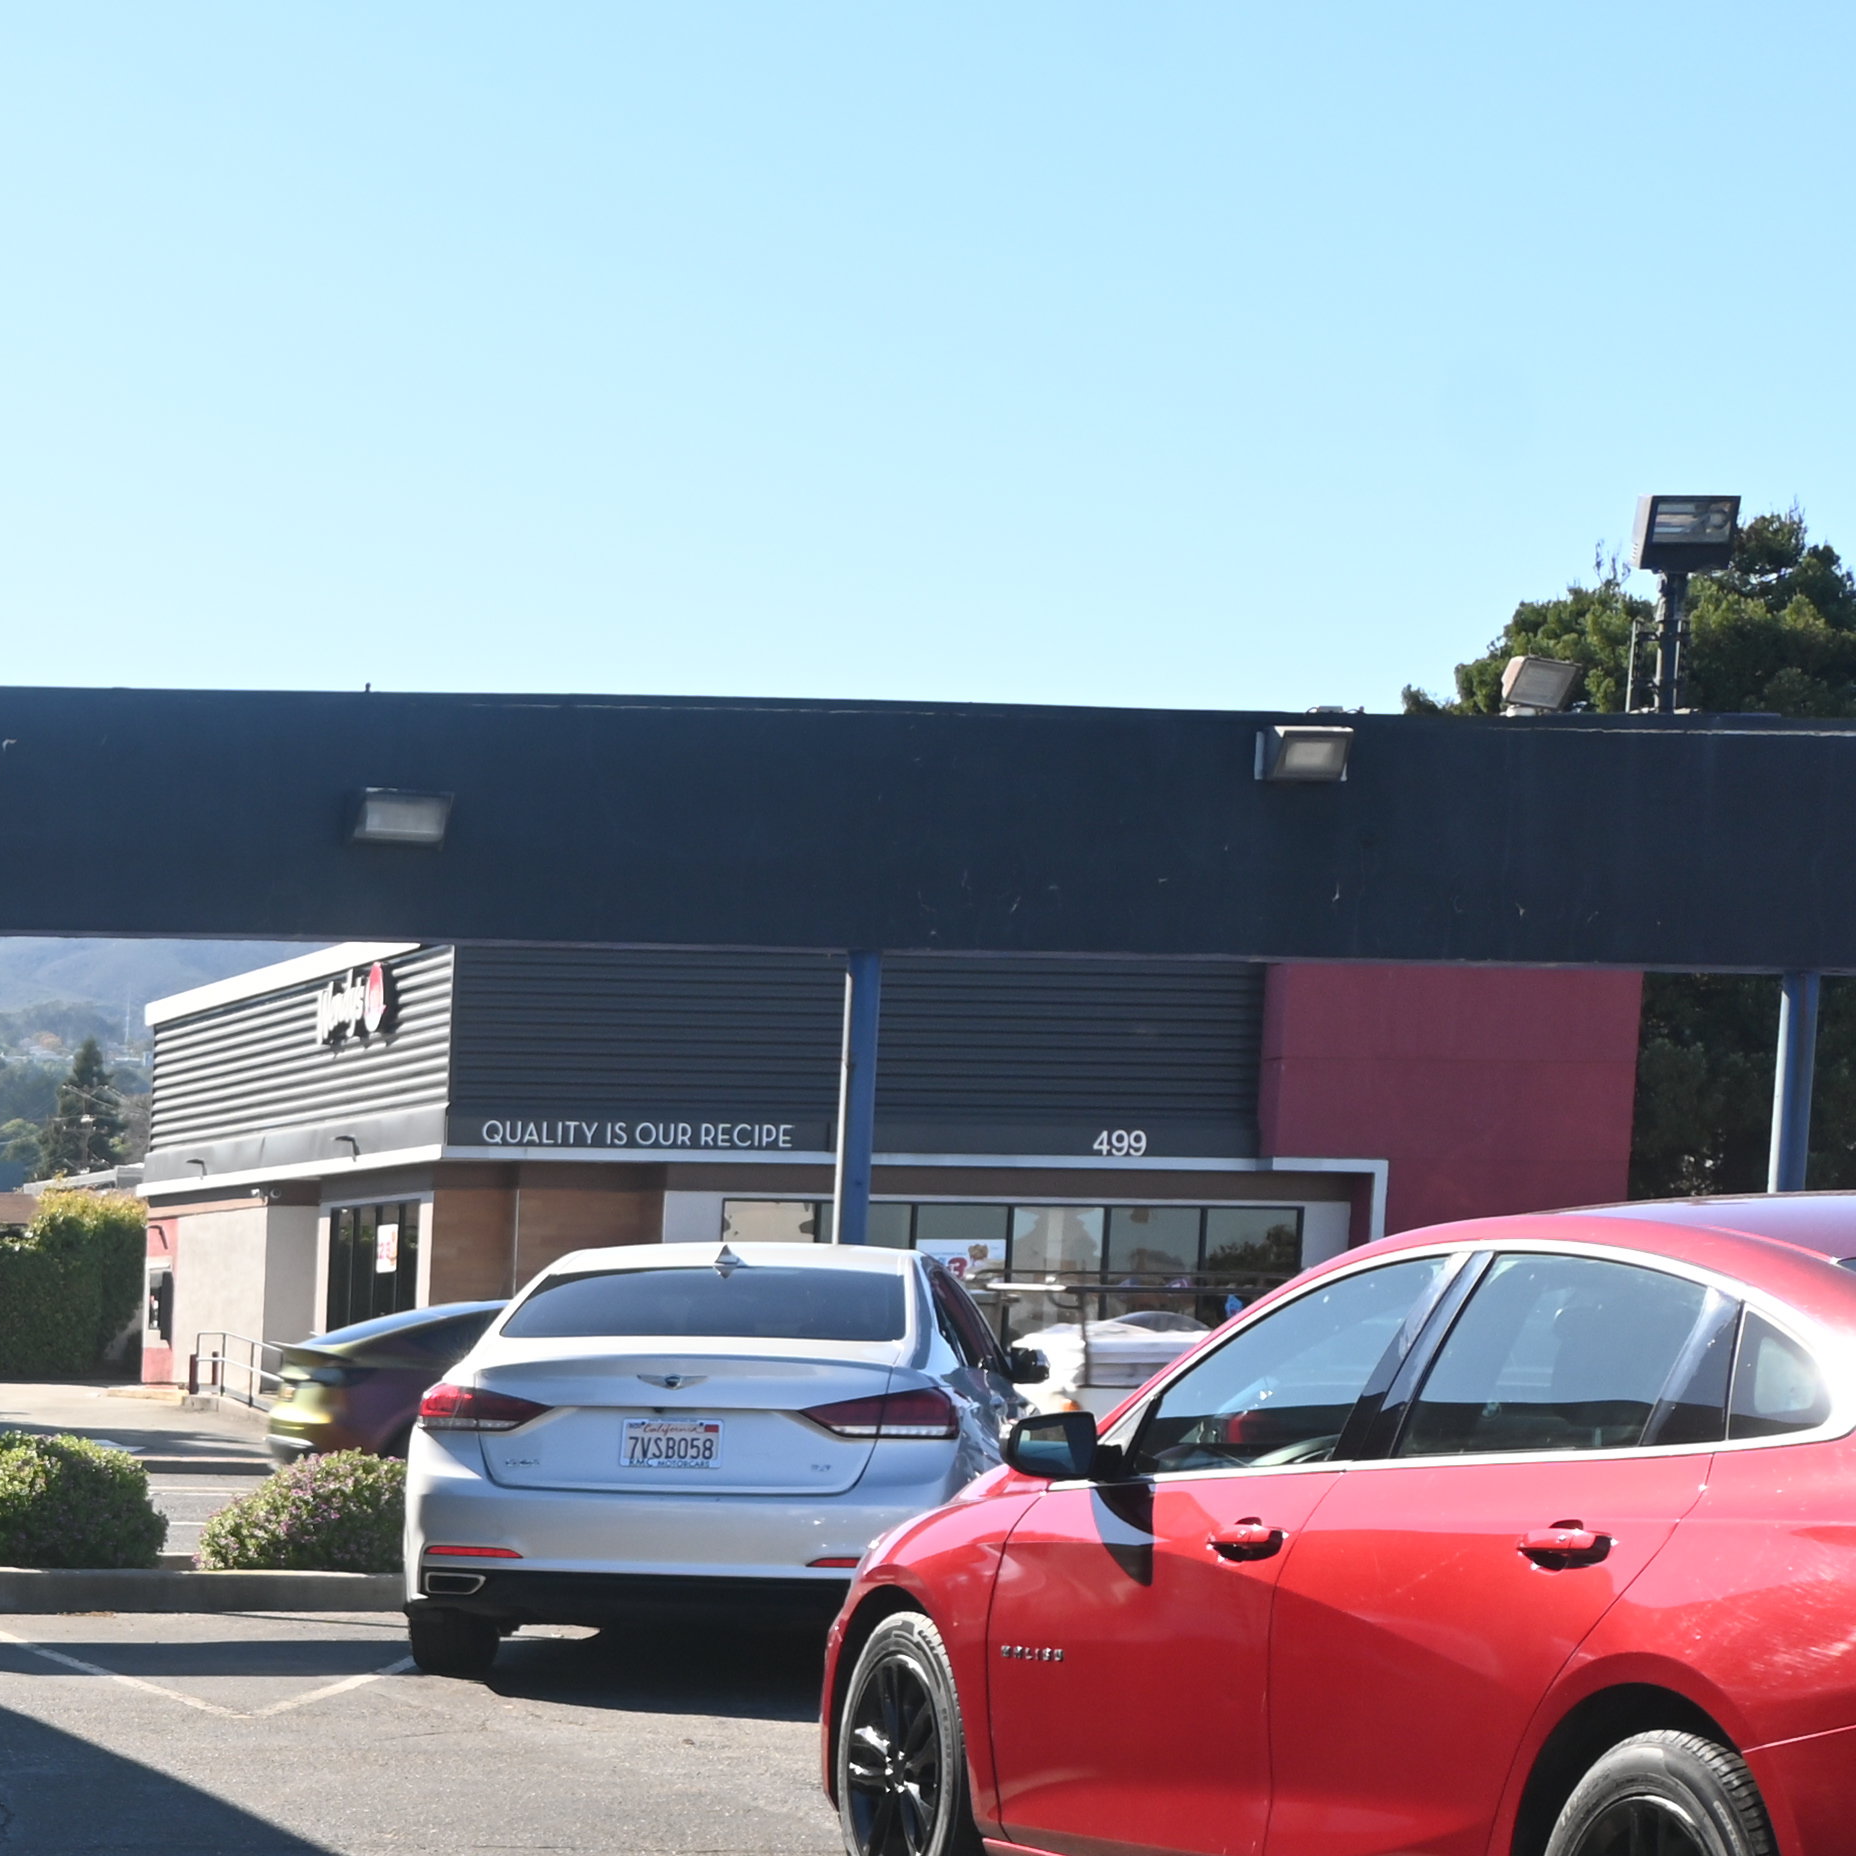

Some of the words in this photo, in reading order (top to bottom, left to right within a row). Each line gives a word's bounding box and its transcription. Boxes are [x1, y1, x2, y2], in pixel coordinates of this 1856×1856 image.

[482, 1120, 598, 1145] QUALITY
[607, 1122, 629, 1145] IS
[636, 1122, 691, 1146] OUR
[700, 1124, 795, 1148] RECIPE
[1092, 1129, 1147, 1156] 499
[643, 1424, 699, 1437] California
[629, 1437, 714, 1460] 7VSB058
